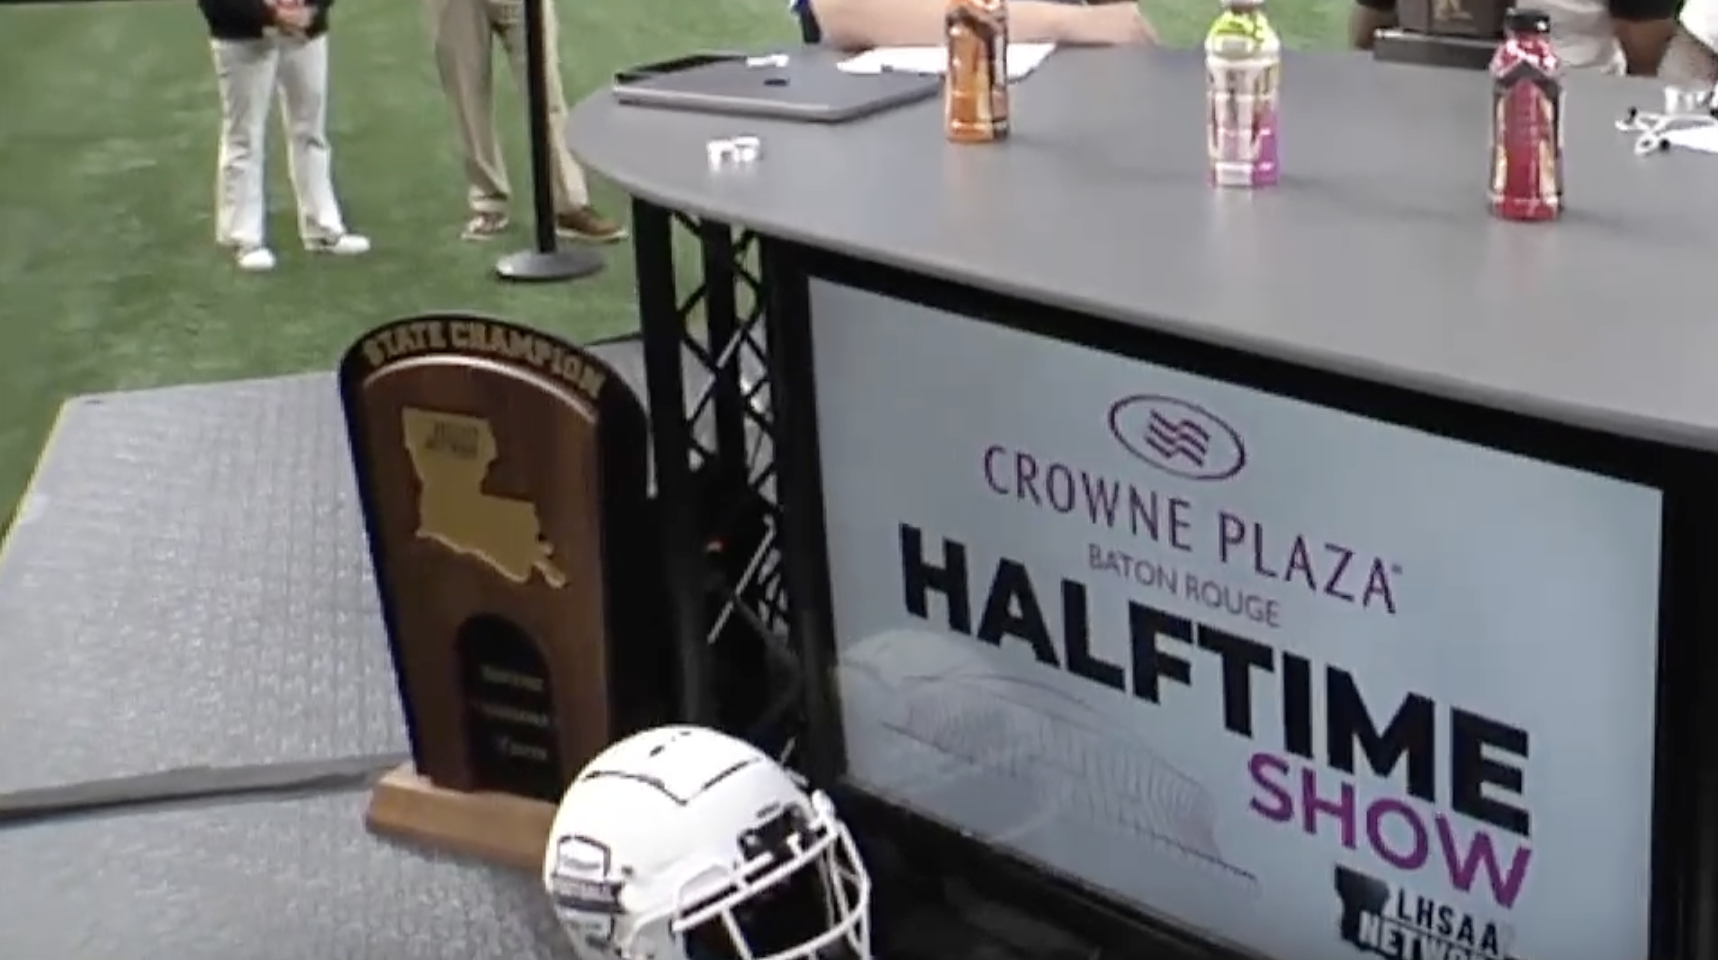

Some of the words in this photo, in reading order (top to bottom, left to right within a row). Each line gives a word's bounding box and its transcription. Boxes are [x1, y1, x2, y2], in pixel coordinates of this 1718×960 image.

[363, 320, 446, 367] STATE
[451, 321, 607, 398] CHAMPION
[984, 445, 1193, 552] CROWNE
[1089, 543, 1179, 596] BATON
[1185, 576, 1281, 629] ROUGE
[899, 523, 1530, 837] HALFTIME
[1246, 751, 1532, 909] SHOW
[1397, 887, 1499, 955] LHSAA
